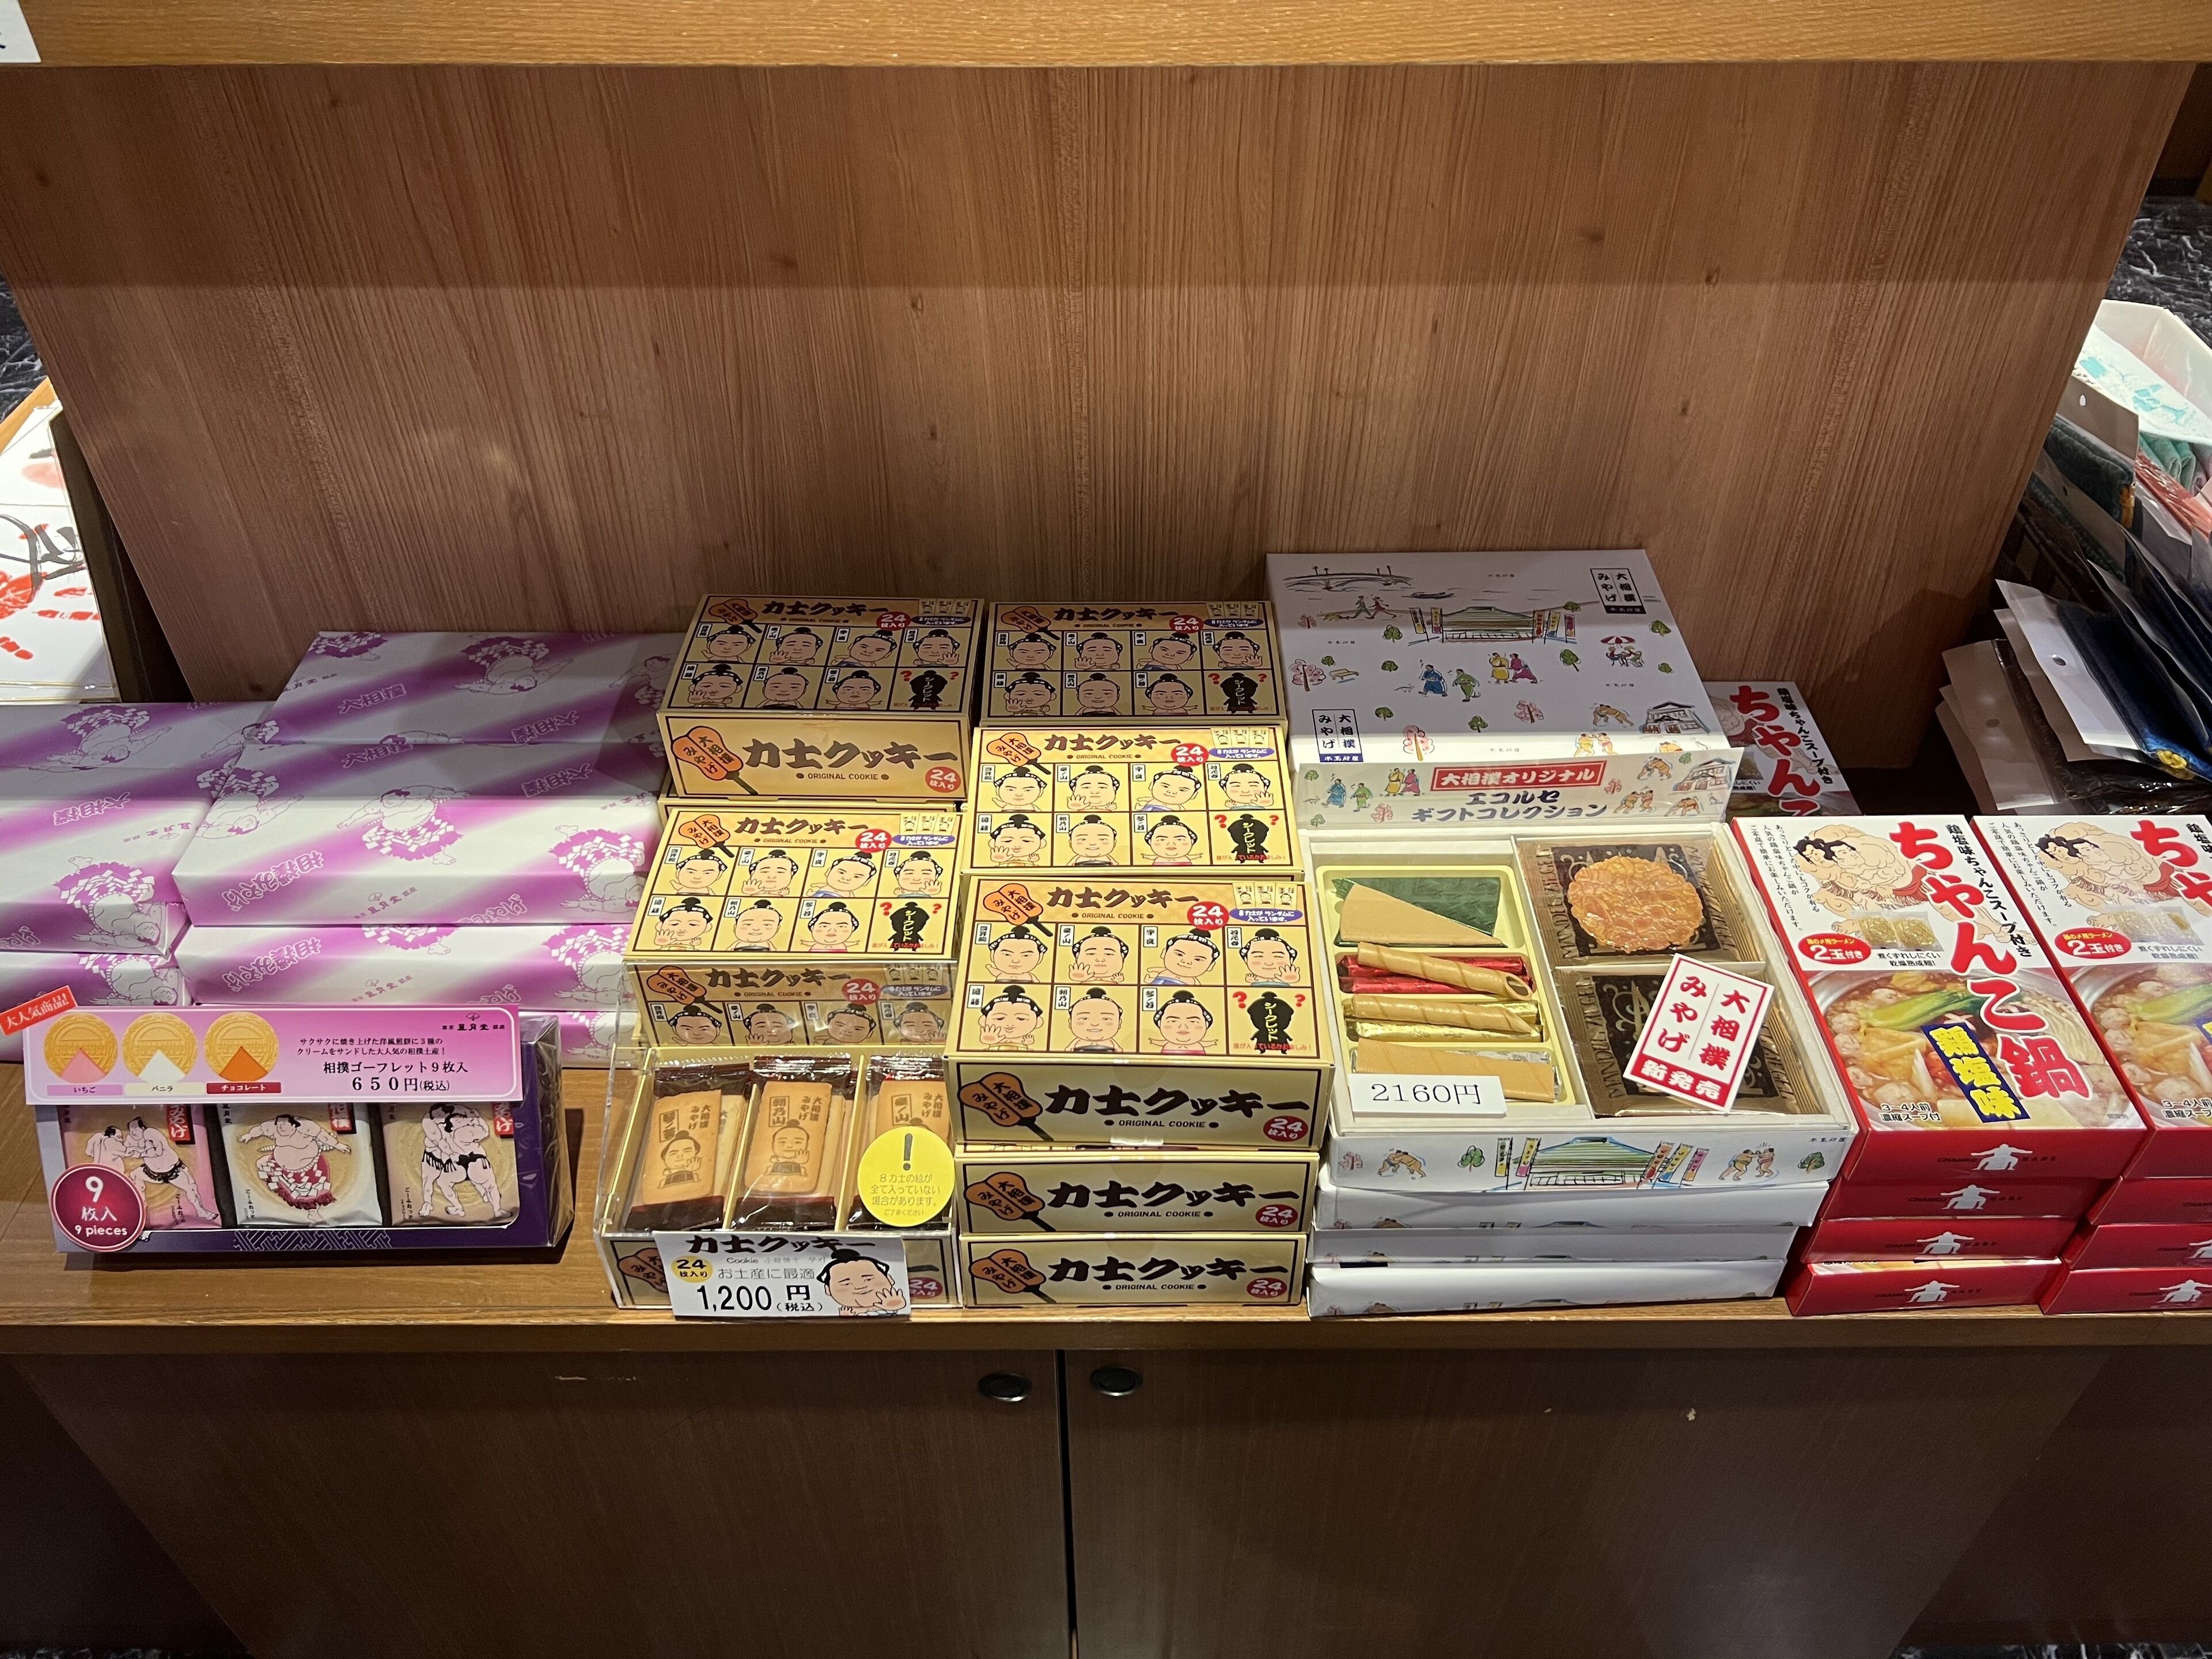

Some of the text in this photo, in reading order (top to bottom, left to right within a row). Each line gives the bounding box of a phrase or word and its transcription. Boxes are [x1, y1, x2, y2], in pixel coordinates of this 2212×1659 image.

[1598, 573, 1616, 601] みやげ
[762, 601, 890, 616] 力士クッキー
[1054, 607, 1179, 622] 力士クッキー
[881, 613, 904, 622] 24
[1173, 617, 1199, 626] 24
[1319, 715, 1335, 748] みやげ
[1339, 714, 1356, 748] 大相撲
[1044, 734, 1181, 752] 力士クッキー
[743, 738, 957, 769] 力士クッキー
[1176, 746, 1203, 756] 24
[1177, 755, 1205, 763] 枚入り
[929, 770, 956, 781] 24
[1441, 768, 1595, 786] 大相撲オリジナル
[929, 780, 956, 789] 枚入り
[1465, 790, 1560, 805] エコルセ
[1411, 804, 1607, 821] ギフトコレクション
[734, 817, 869, 835] 力士クッキー
[860, 832, 887, 843] 24
[1243, 822, 1255, 853] シークレット
[1047, 887, 1199, 907] 力士クッキー
[1946, 825, 2032, 957] 鶏塩味ちゃんこスープ付き
[1192, 906, 1223, 917] 24
[902, 910, 914, 941] シークレット
[1194, 916, 1224, 926] 枚入り
[1809, 945, 1863, 960] 2玉付き
[2072, 940, 2124, 956] 2玉付き
[1889, 821, 2092, 1099] ちゃんこ鍋
[707, 968, 851, 988] 力士クッキー
[847, 982, 873, 994] 24
[849, 992, 877, 1000] 枚入り
[1263, 1002, 1279, 1040] シークレット
[1657, 976, 1707, 1052] みやげ
[1699, 990, 1751, 1071] 大相撲
[1929, 1025, 2021, 1118] 鶏塩味
[1640, 1059, 1721, 1100] 新発売
[221, 1083, 267, 1092] チョコレート
[1371, 1082, 1482, 1105] 2160円
[799, 1096, 810, 1120] みやげ
[922, 1093, 932, 1117] みやげ
[1045, 1085, 1310, 1117] 力士クッキー
[700, 1105, 711, 1128] 大相撲
[772, 1098, 786, 1125] 朝乃山
[810, 1097, 821, 1121] 大相撲
[1880, 1112, 1941, 1121] 濃縮スープ付
[688, 1106, 700, 1130] みやげ
[1119, 1119, 1165, 1127] ORIGINAL
[1270, 1118, 1302, 1131] 24
[1268, 1128, 1297, 1139] 枚入り
[880, 1174, 933, 1183] 8力士の絵が
[85, 1176, 103, 1202] 9
[871, 1185, 940, 1194] 全て入っていない
[1047, 1180, 1300, 1209] 力士クッキー
[872, 1196, 936, 1206] 場合があります。
[81, 1206, 117, 1221] 枚入
[1264, 1206, 1294, 1218] 24
[1260, 1215, 1288, 1225] 枚入り
[75, 1225, 127, 1237] 9 pieces
[687, 1235, 876, 1253] 力士クッキー
[676, 1260, 704, 1269] 24
[1048, 1256, 1288, 1283] 力士クッキー
[679, 1270, 708, 1278] 枚入り
[718, 1268, 814, 1279] お土産に最適
[910, 1279, 935, 1290] 24
[1251, 1287, 1278, 1297] 枚入り
[1255, 1279, 1283, 1290] 24
[697, 1285, 810, 1312] 1,200 円
[777, 1302, 823, 1312] (税込)
